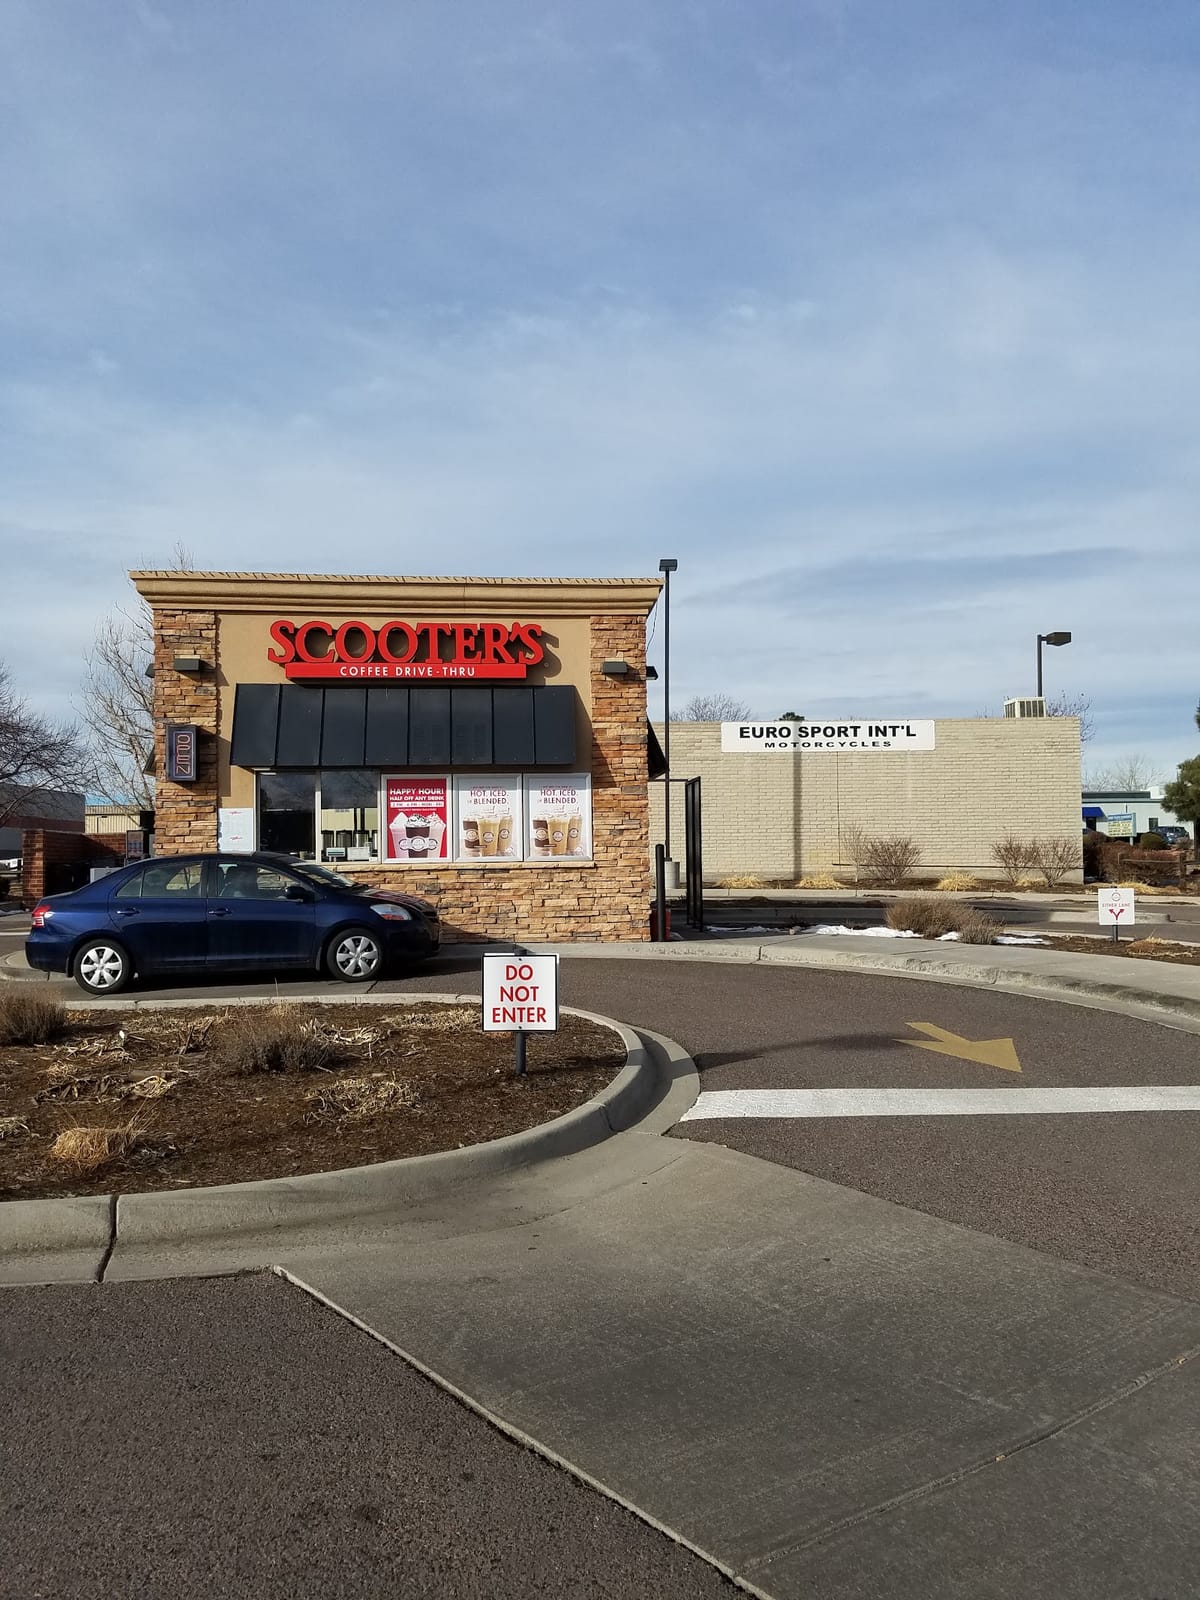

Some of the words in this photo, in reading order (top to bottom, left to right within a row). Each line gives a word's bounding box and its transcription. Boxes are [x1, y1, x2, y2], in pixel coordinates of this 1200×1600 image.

[268, 620, 544, 665] SCOOTER'S
[340, 666, 389, 676] COFFEE
[739, 726, 792, 738] EURO
[798, 725, 861, 738] SPORT
[868, 725, 916, 737] INT'L
[176, 734, 191, 775] OPEN
[505, 964, 534, 981] DO
[500, 985, 540, 1002] NOT
[492, 1006, 547, 1023] ENTER
